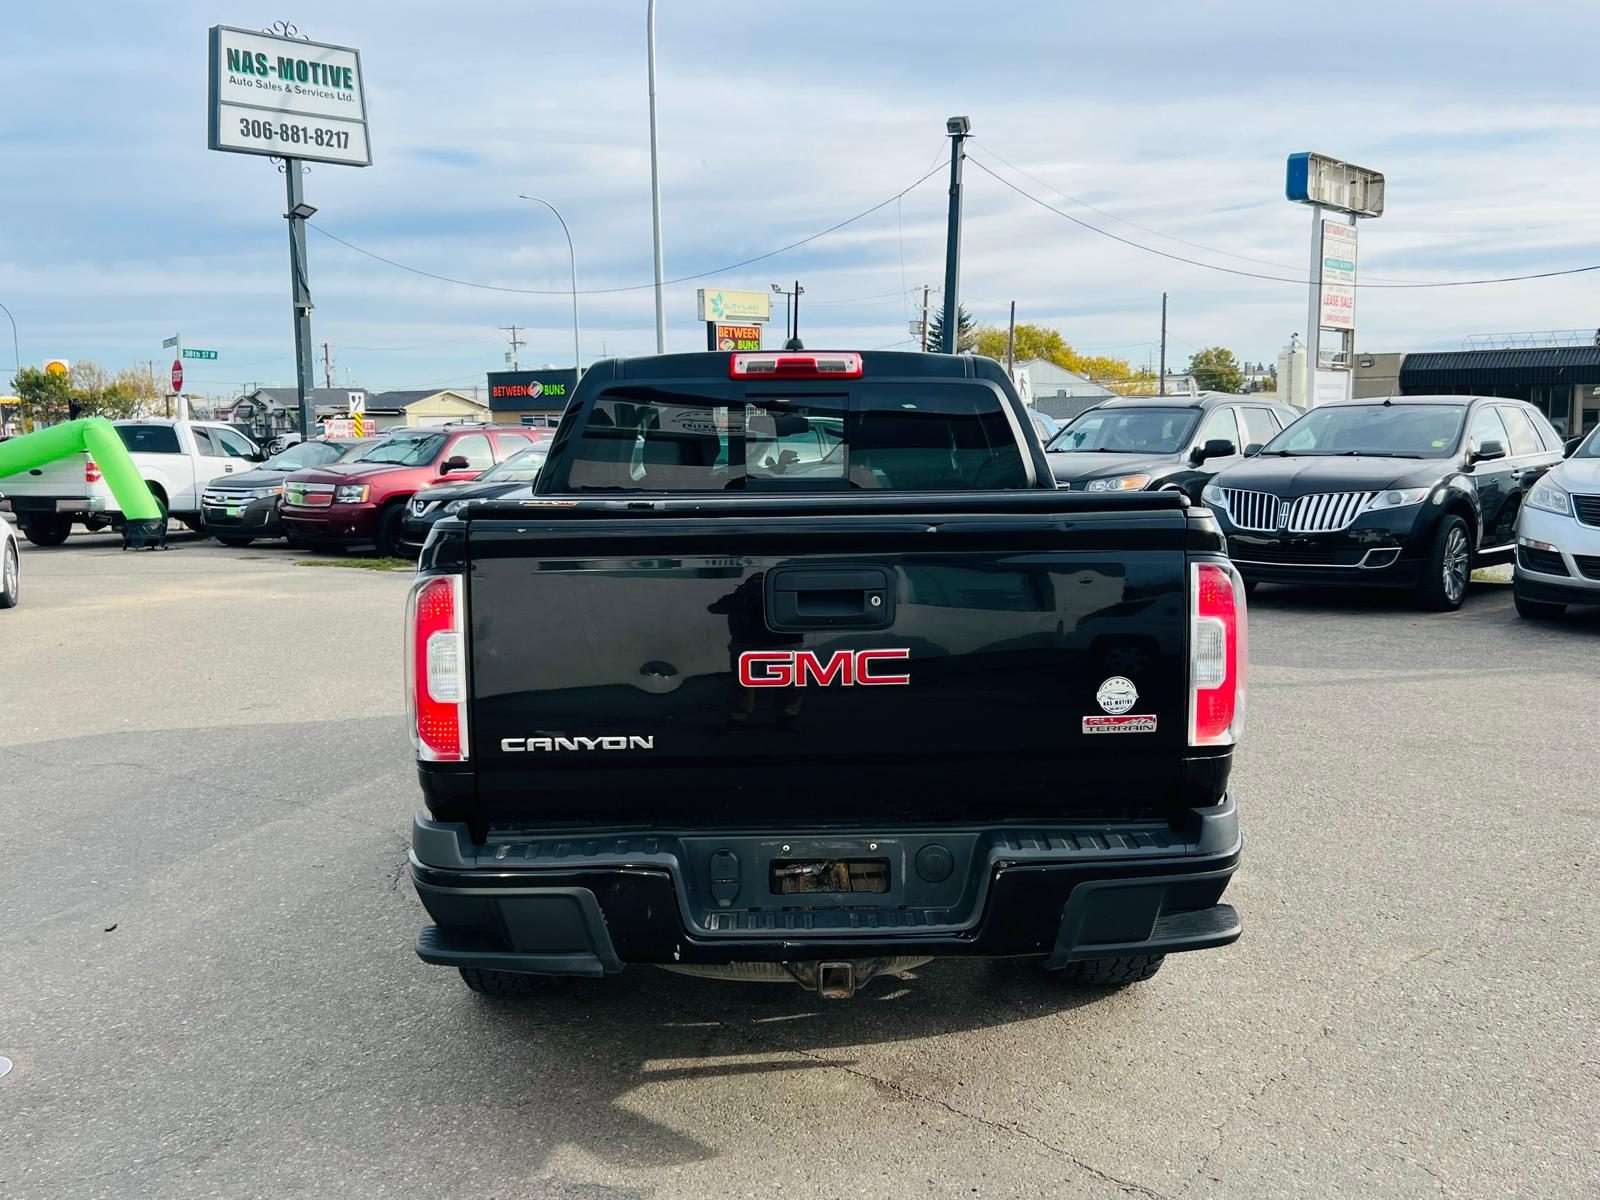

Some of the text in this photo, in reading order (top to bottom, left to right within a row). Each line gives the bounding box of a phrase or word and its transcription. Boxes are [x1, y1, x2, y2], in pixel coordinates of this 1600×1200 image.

[226, 48, 353, 90] NAS-MOTIVE
[229, 75, 356, 102] Auto Sales & Services Ltd.
[240, 118, 349, 149] 306-881-8217
[1339, 296, 1353, 309] SALE
[719, 326, 759, 339] BETWEEN
[738, 340, 759, 350] BUNS
[210, 352, 217, 360] W
[172, 370, 183, 382] STOP
[493, 384, 566, 397] BETWEEN BUNS
[738, 647, 911, 688] GMC
[1089, 717, 1119, 725] ALL
[500, 735, 655, 753] CANYON
